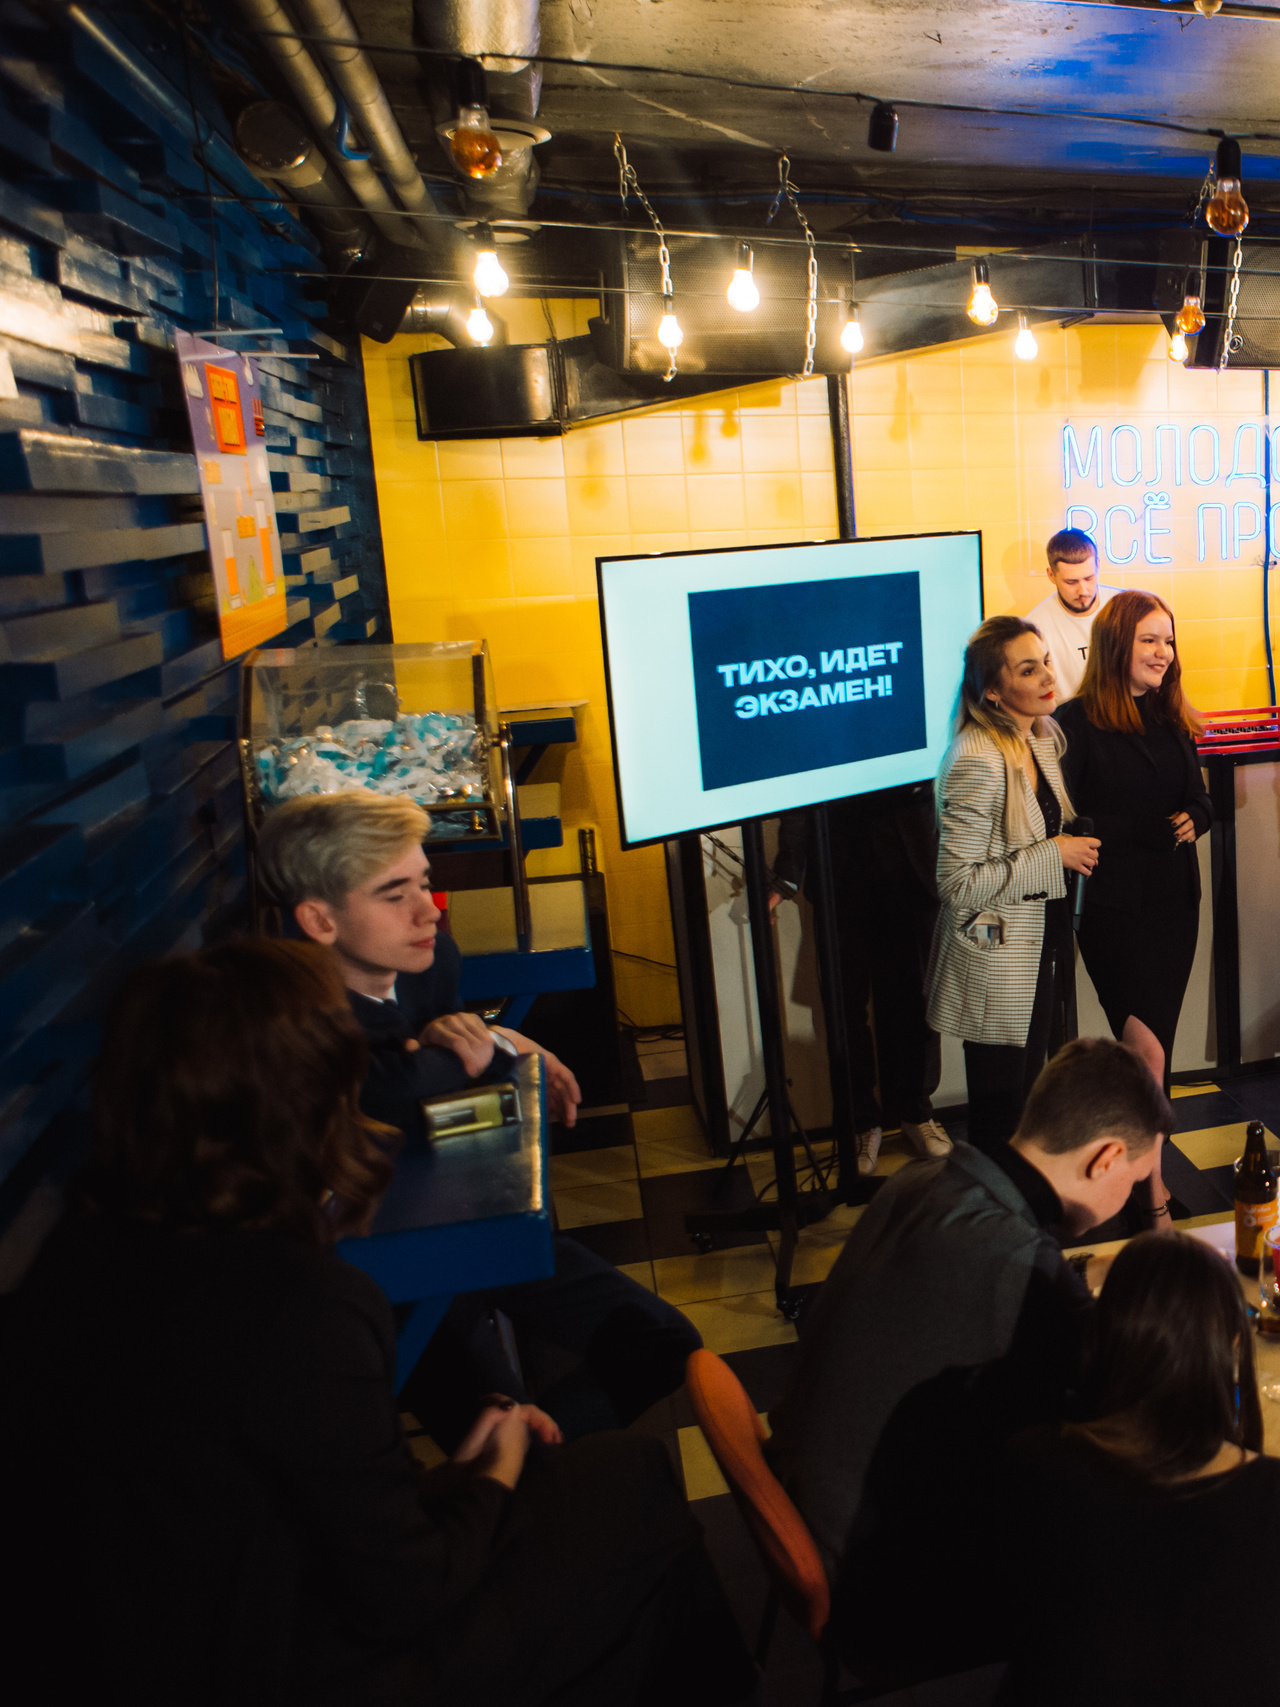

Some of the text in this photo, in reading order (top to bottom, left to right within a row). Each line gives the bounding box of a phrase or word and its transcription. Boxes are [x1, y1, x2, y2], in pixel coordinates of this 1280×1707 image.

[717, 641, 904, 688] ТИХО, ИДЕТ
[734, 675, 894, 719] ЭКЗАМЕН!
